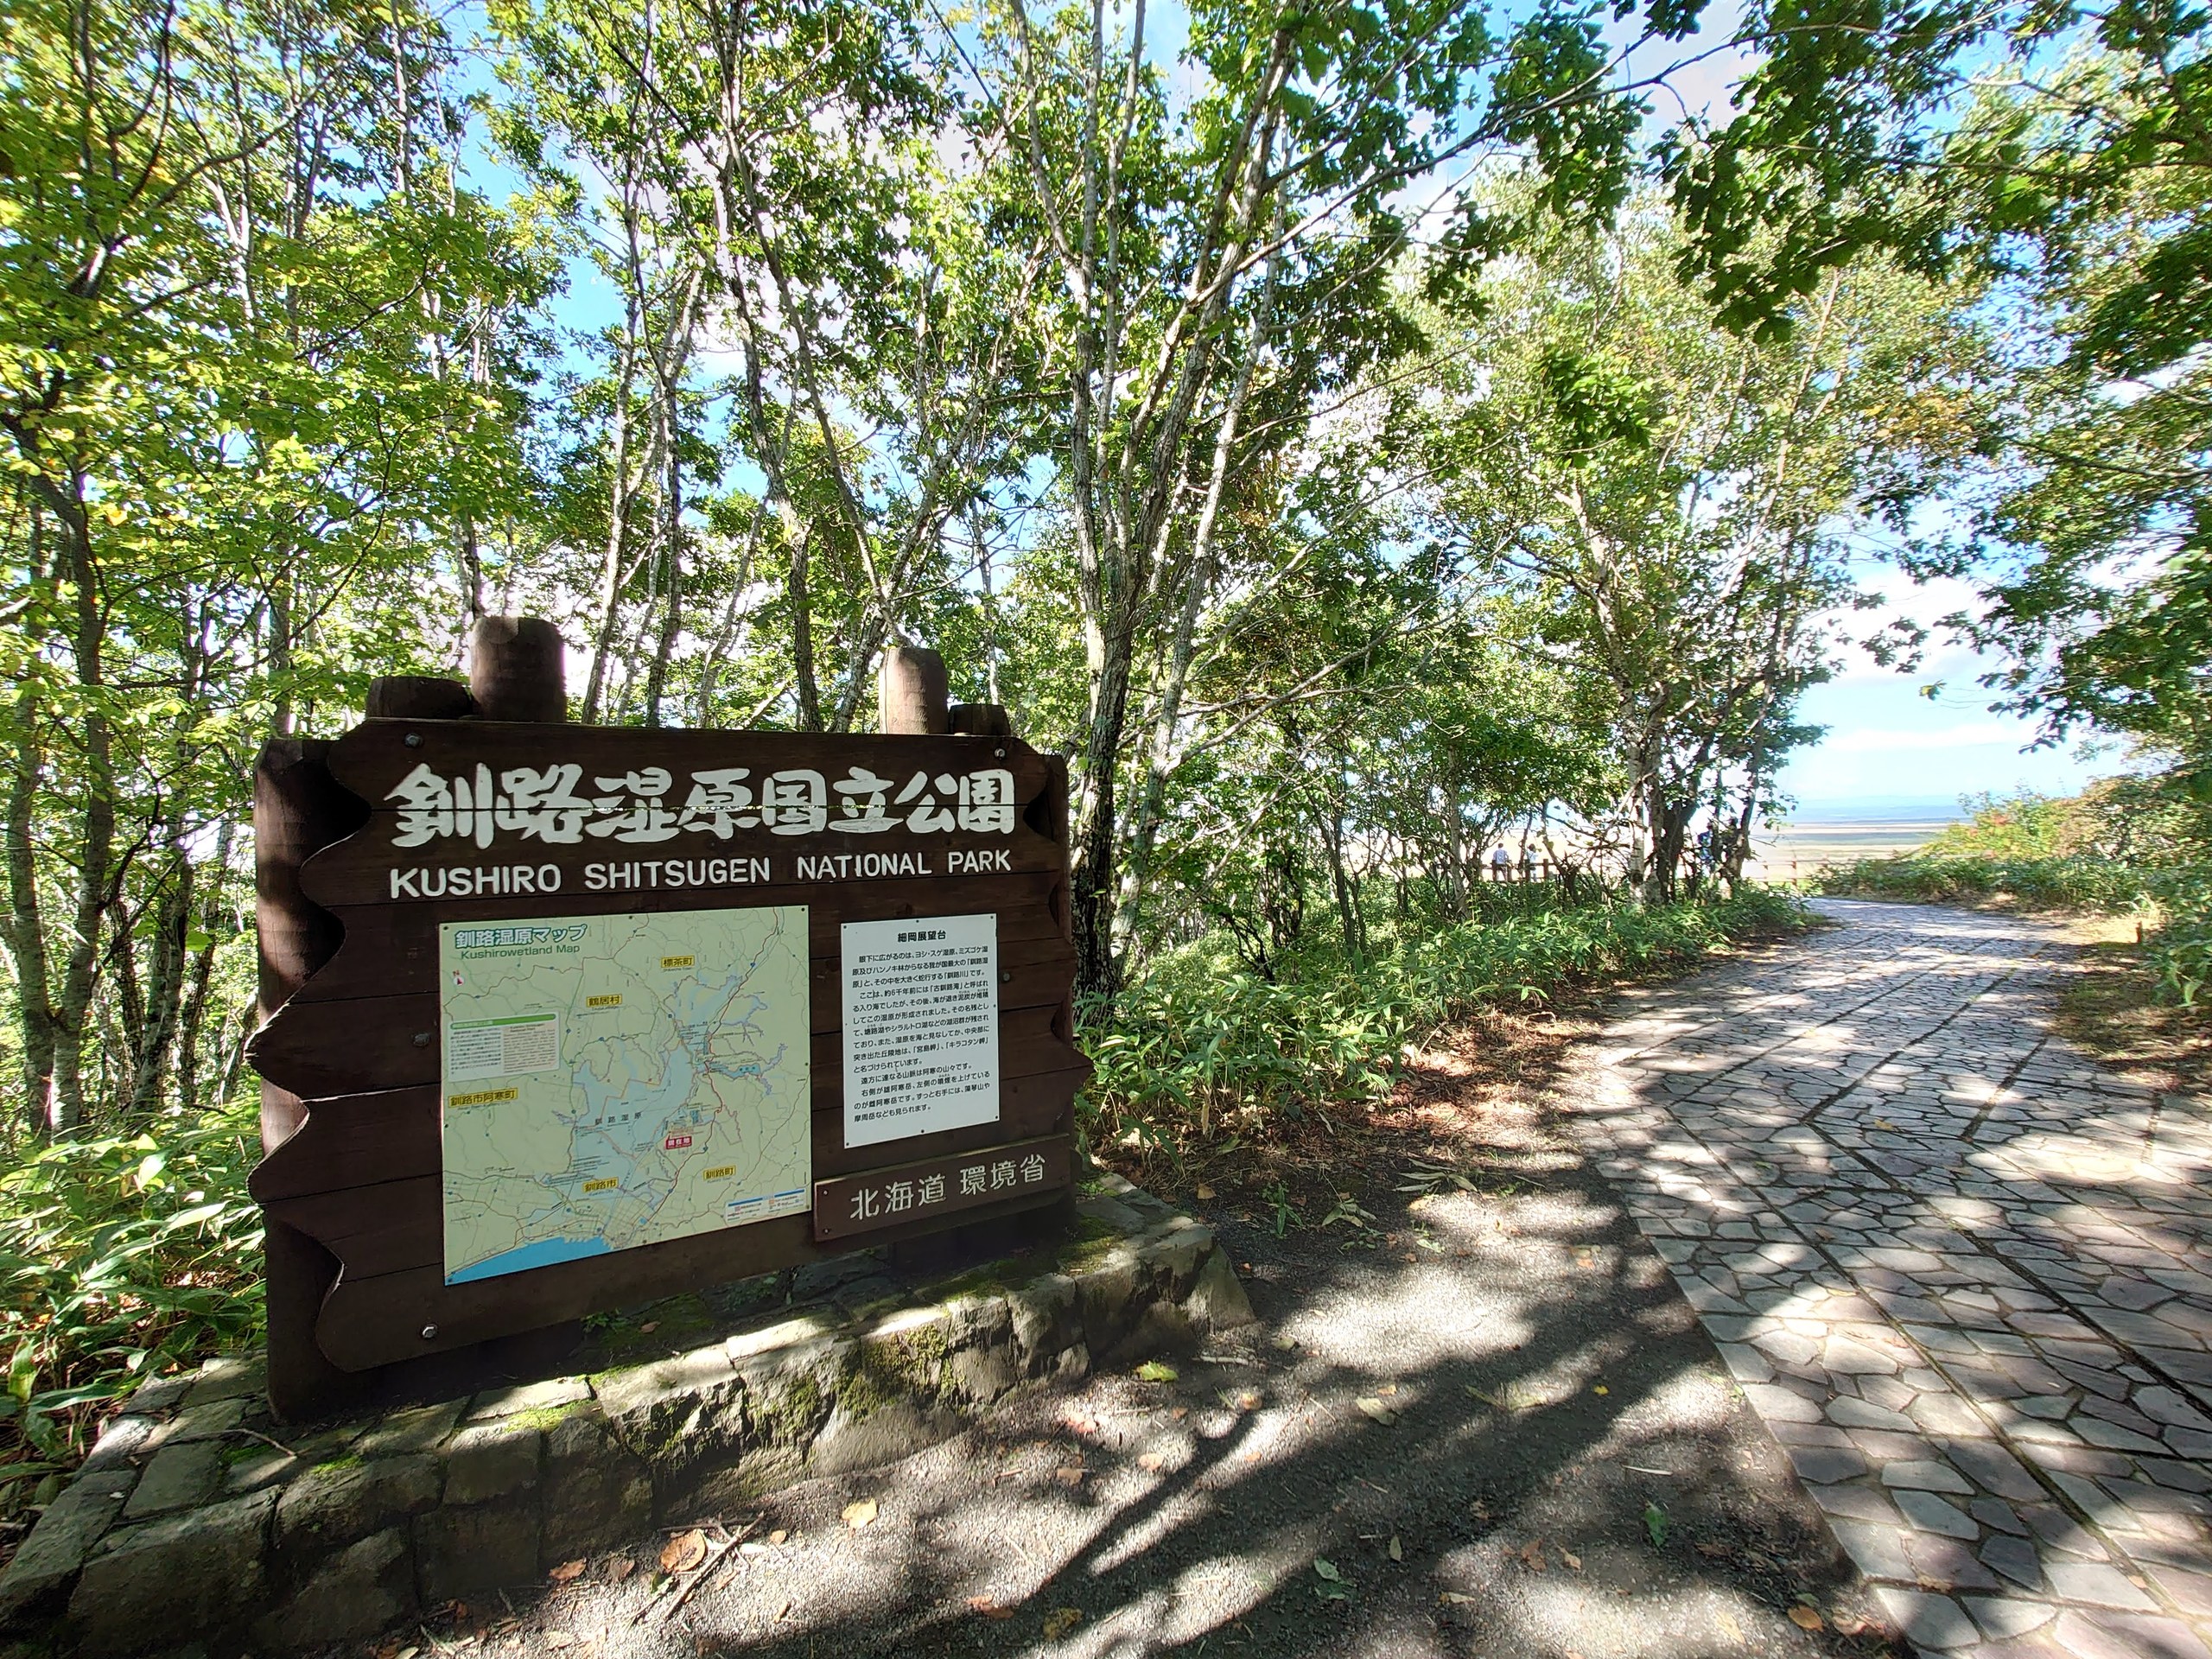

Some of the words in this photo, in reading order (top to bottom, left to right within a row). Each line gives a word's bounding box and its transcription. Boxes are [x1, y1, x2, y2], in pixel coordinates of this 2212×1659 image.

[384, 762, 1015, 849] 釧路湿原国立公園
[391, 864, 562, 899] KUSHIRO
[584, 856, 771, 890] SHITSUGEN
[798, 851, 932, 880] NATIONAL
[948, 849, 1012, 874] PARK
[454, 924, 588, 949] 釧路湿原マップ
[556, 944, 580, 956] Map
[898, 930, 947, 943] 細岡展望台
[849, 1173, 946, 1221] 北海道
[960, 1154, 1046, 1196] 環境省
